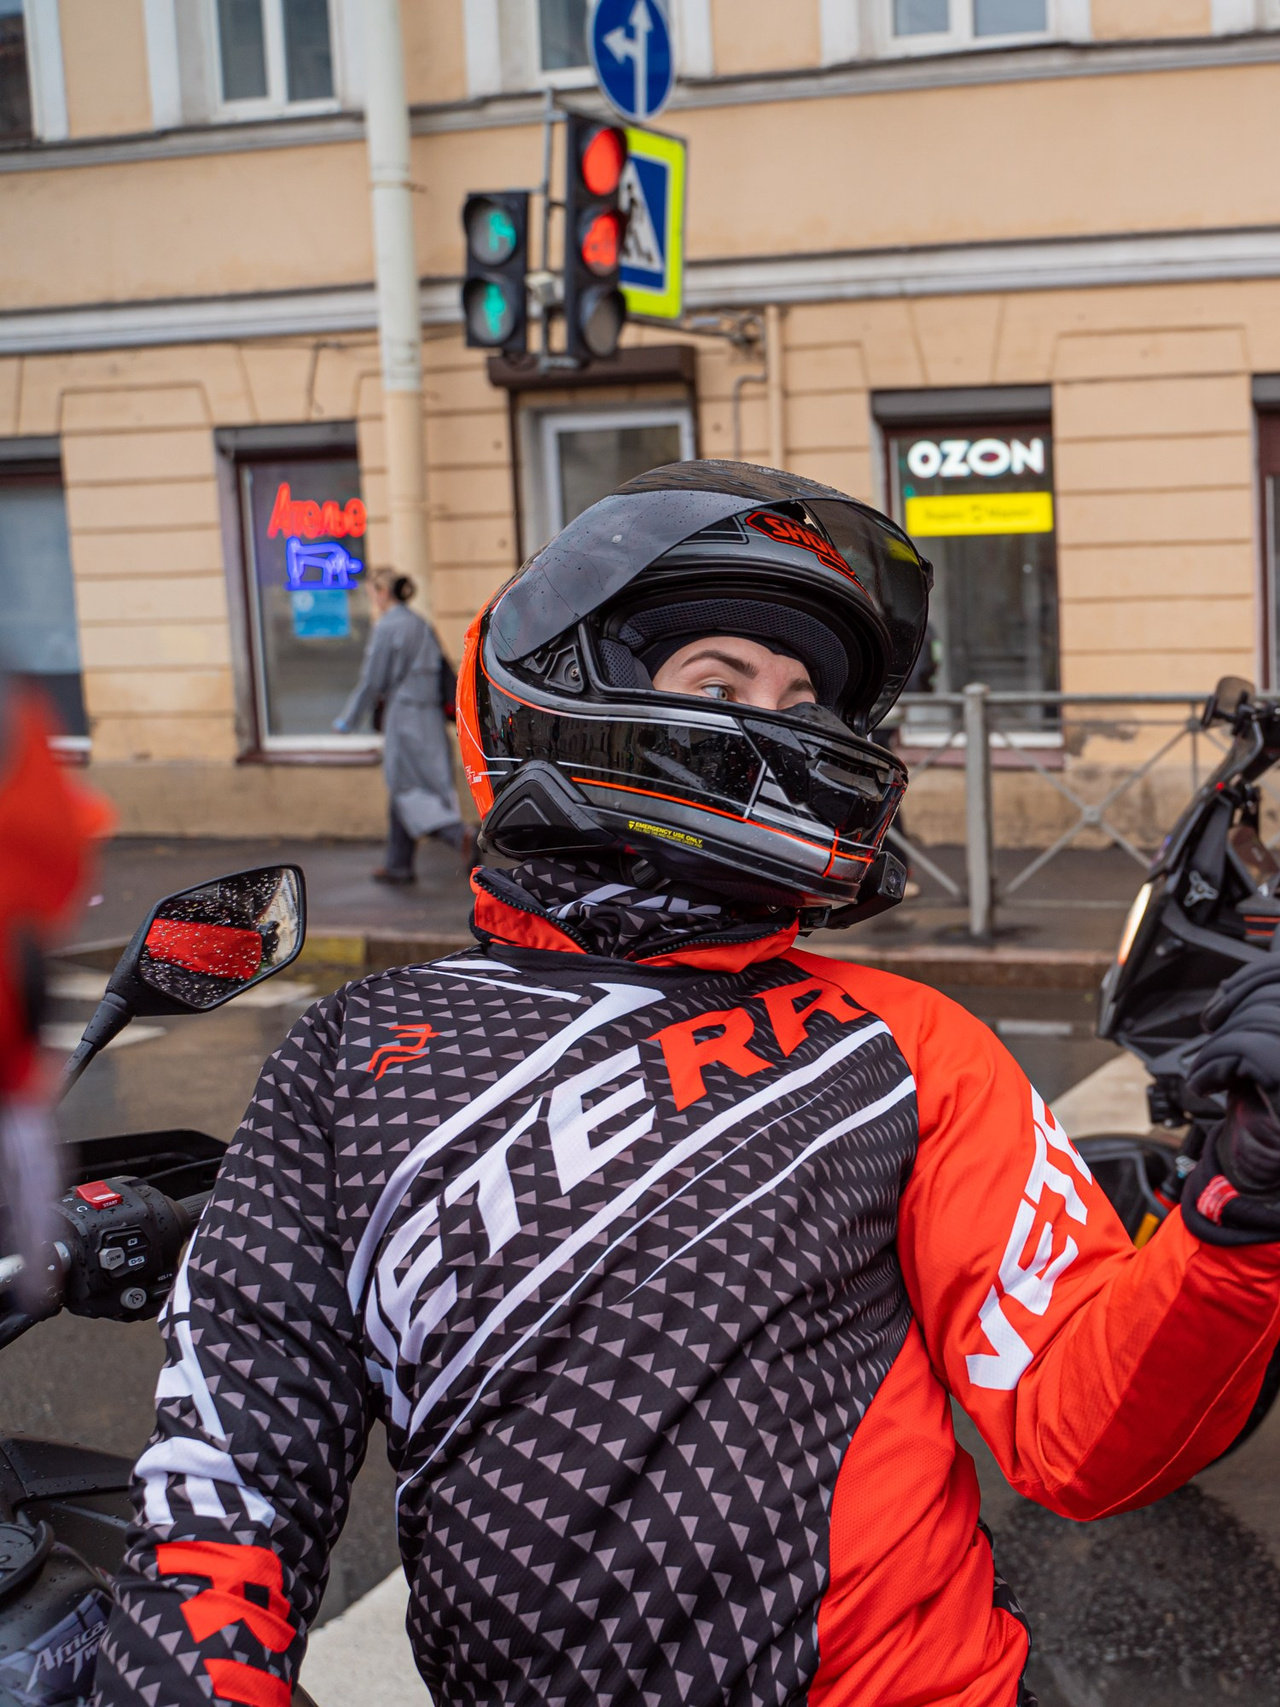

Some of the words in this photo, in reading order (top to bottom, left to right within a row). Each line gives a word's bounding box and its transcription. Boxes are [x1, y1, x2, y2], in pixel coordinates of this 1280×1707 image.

[907, 438, 1045, 478] OZON
[635, 821, 673, 836] EMERGENCY
[672, 830, 686, 840] USE
[685, 834, 704, 845] ONLY
[102, 1199, 118, 1208] START
[25, 1620, 109, 1694] Africa
[64, 1636, 100, 1684] Tw
